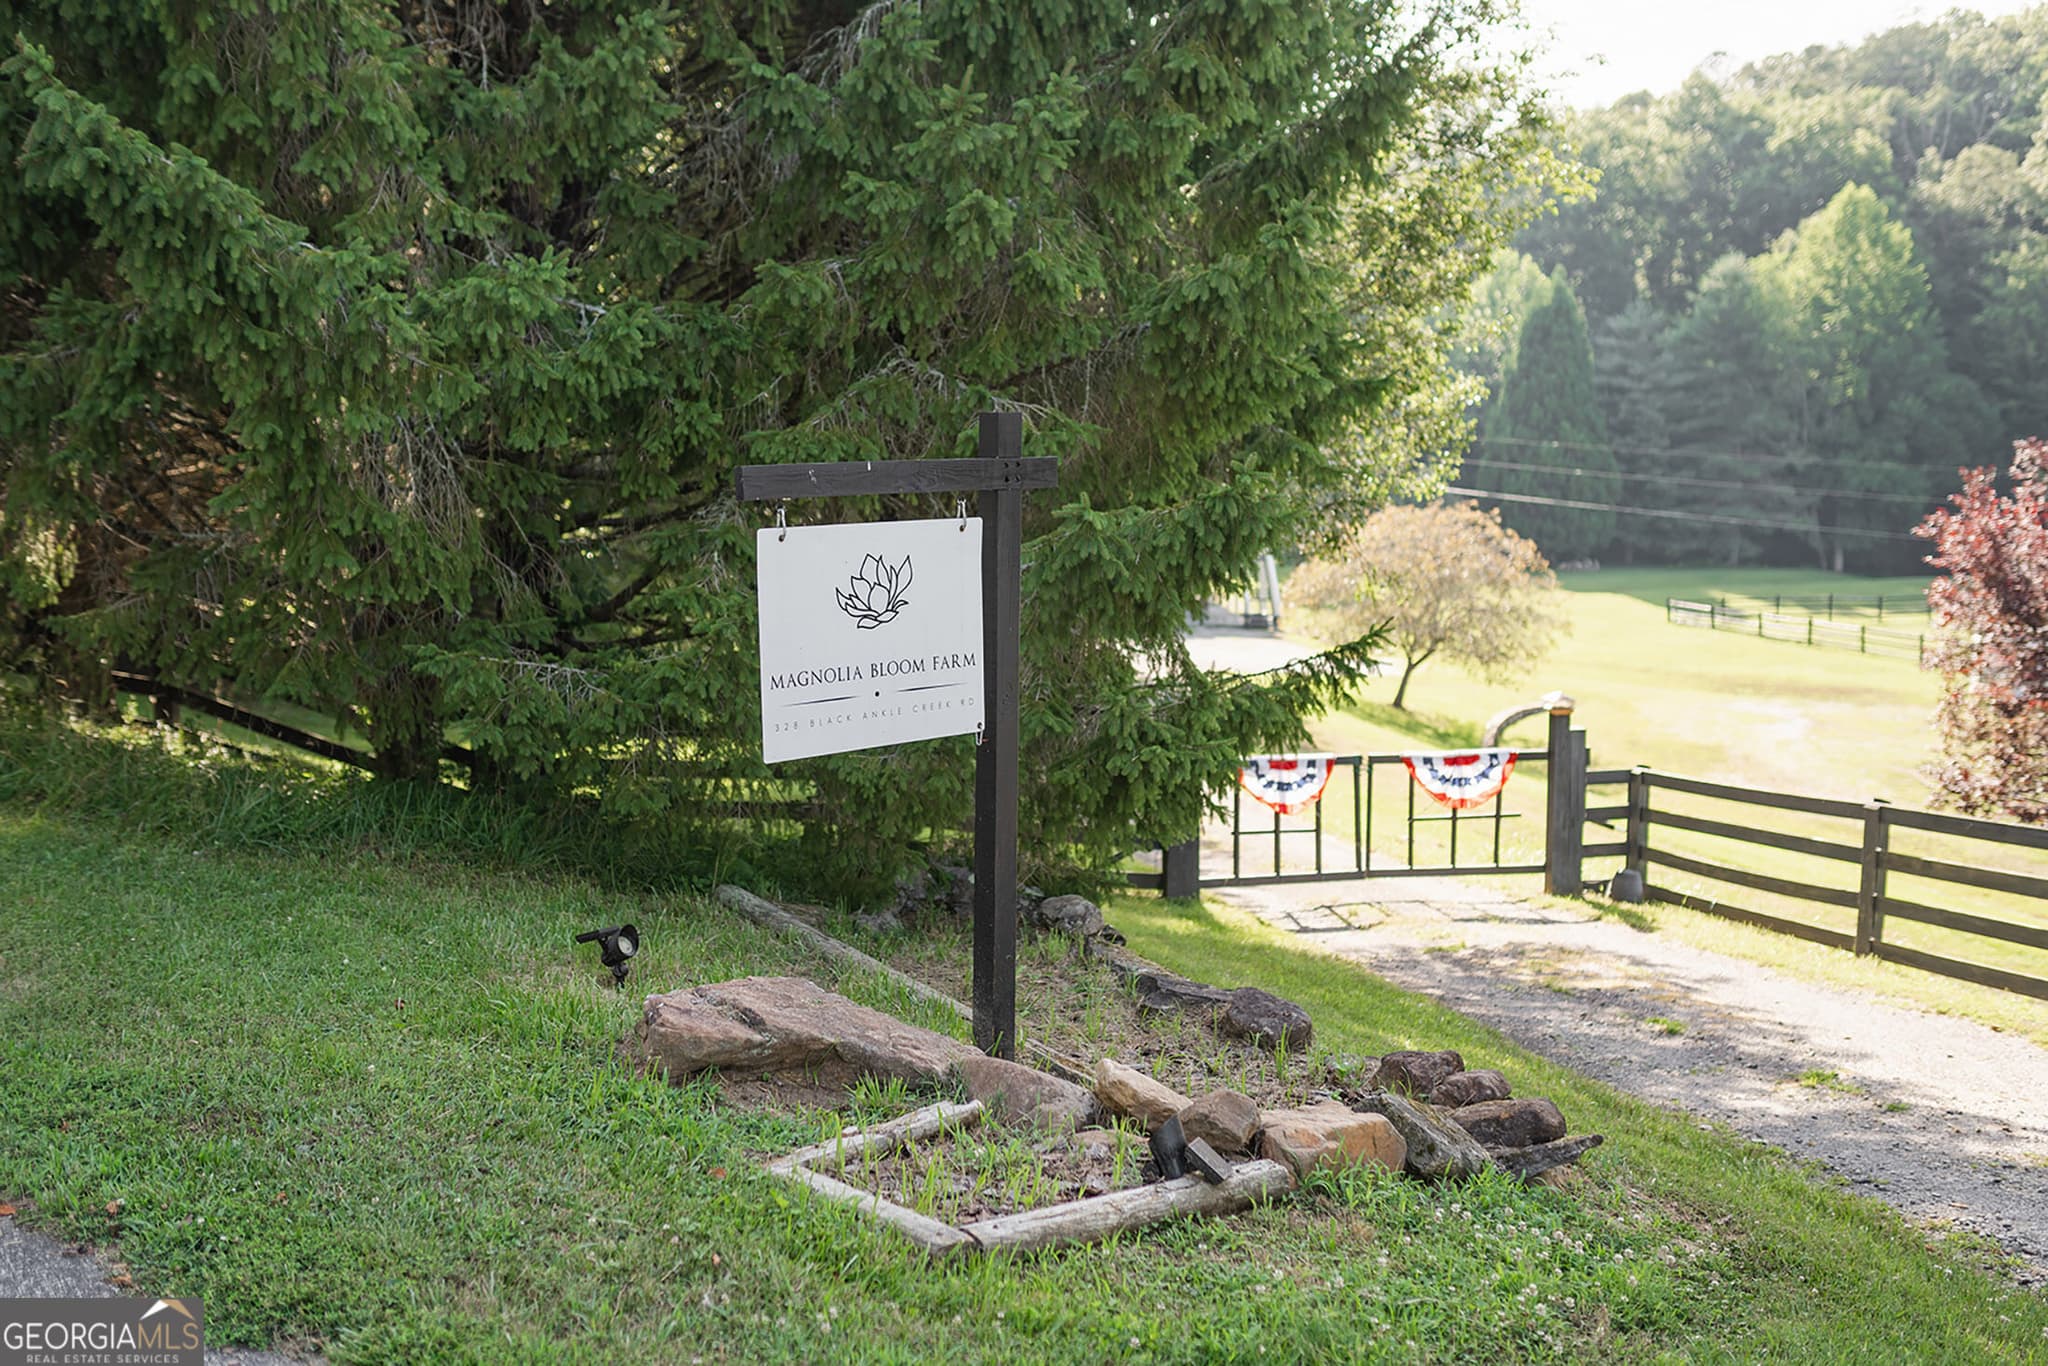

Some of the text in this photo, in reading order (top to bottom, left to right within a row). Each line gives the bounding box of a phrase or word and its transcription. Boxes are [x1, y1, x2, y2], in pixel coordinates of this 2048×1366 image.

[769, 653, 977, 690] MAGNOLIA BLOOM FARM
[809, 714, 852, 728] BLACK
[862, 706, 902, 720] ANKLE
[912, 700, 951, 713] CREEK
[960, 697, 975, 707] RD
